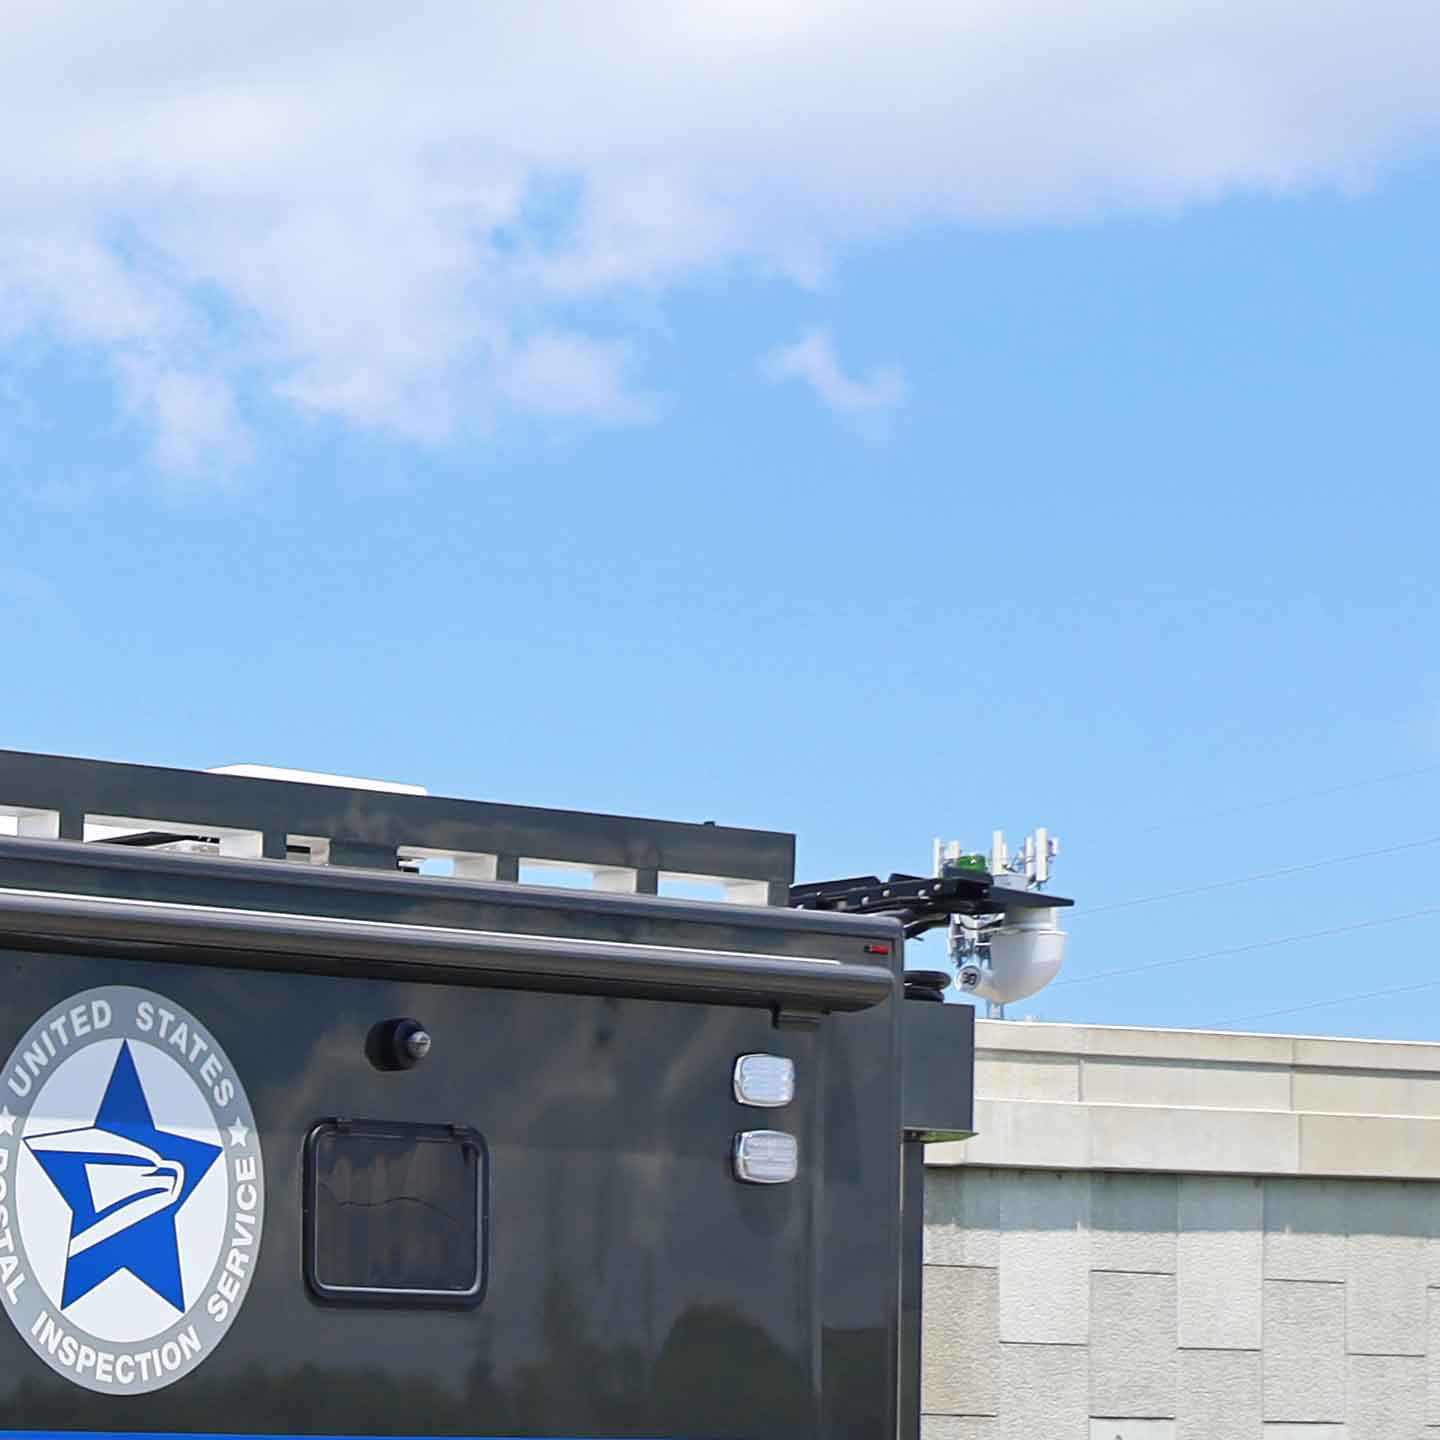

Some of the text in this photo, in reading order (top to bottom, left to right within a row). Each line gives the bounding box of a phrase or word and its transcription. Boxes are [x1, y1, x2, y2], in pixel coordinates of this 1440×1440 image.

[7, 999, 235, 1107] UNITED STATES
[31, 1310, 203, 1385] INSPECTION
[207, 1156, 258, 1322] SERVICE
